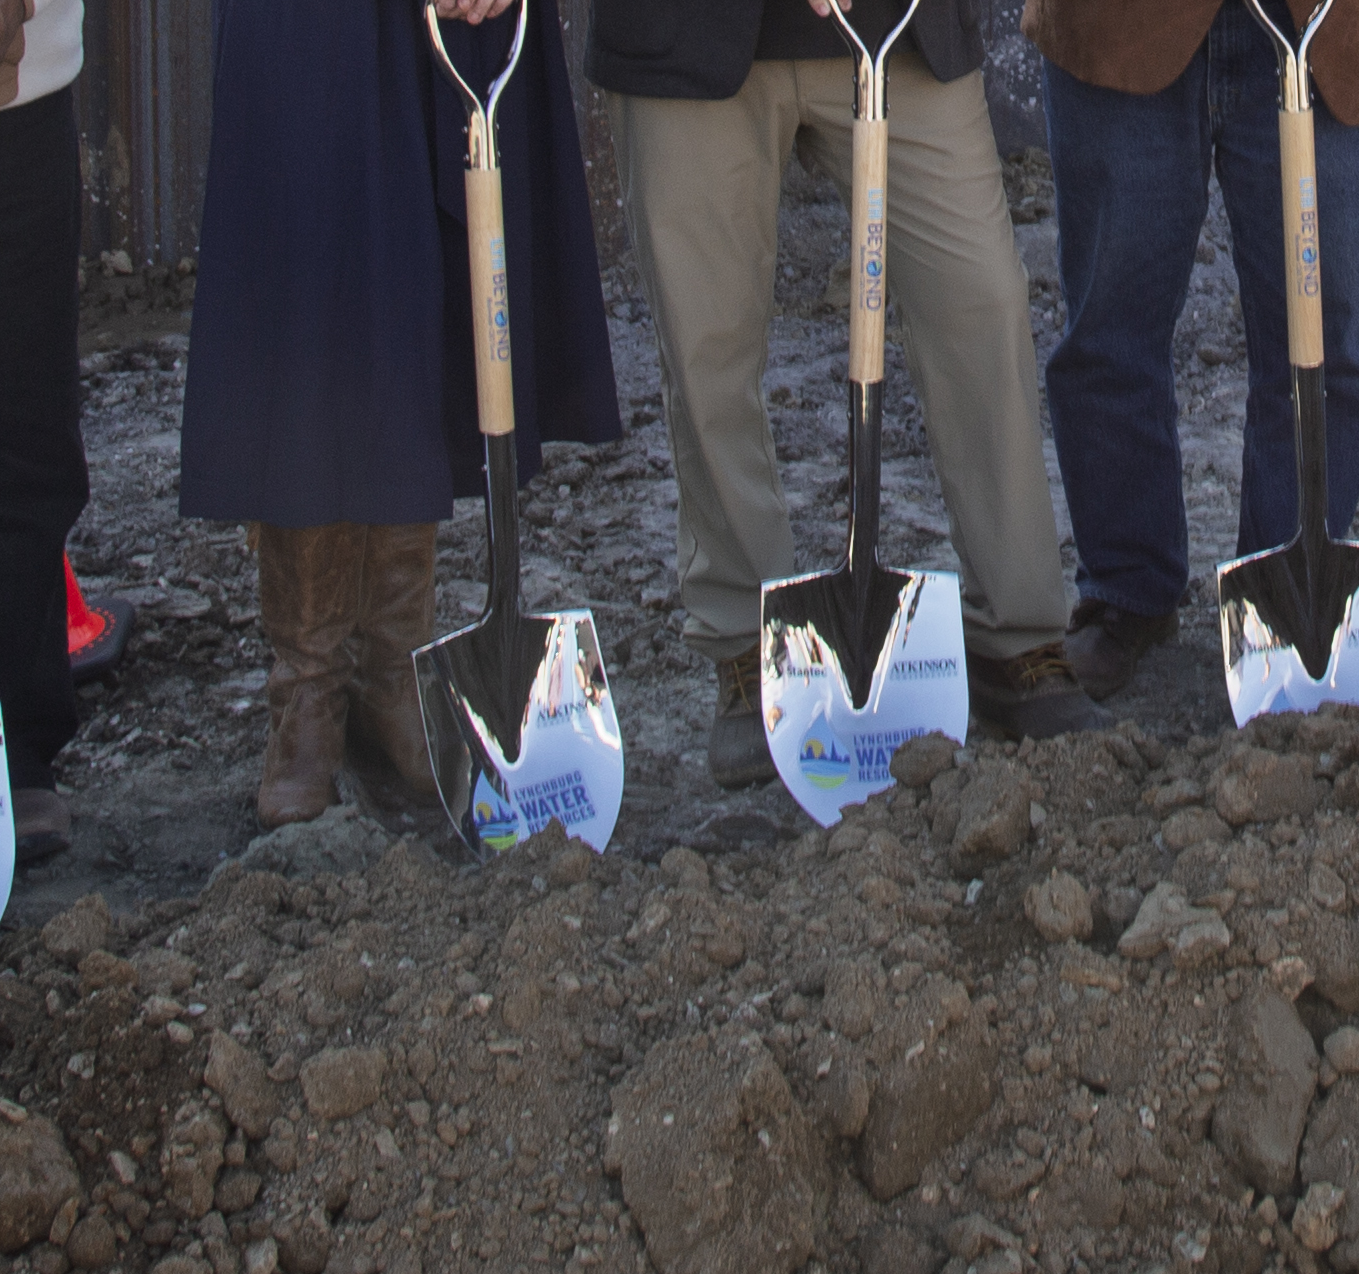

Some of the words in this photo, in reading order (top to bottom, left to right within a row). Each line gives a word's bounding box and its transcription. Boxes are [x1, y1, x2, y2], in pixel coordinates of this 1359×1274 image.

[893, 658, 957, 674] ATKINSON
[514, 769, 582, 802] LYNCHBURG
[520, 785, 590, 821] WATER
